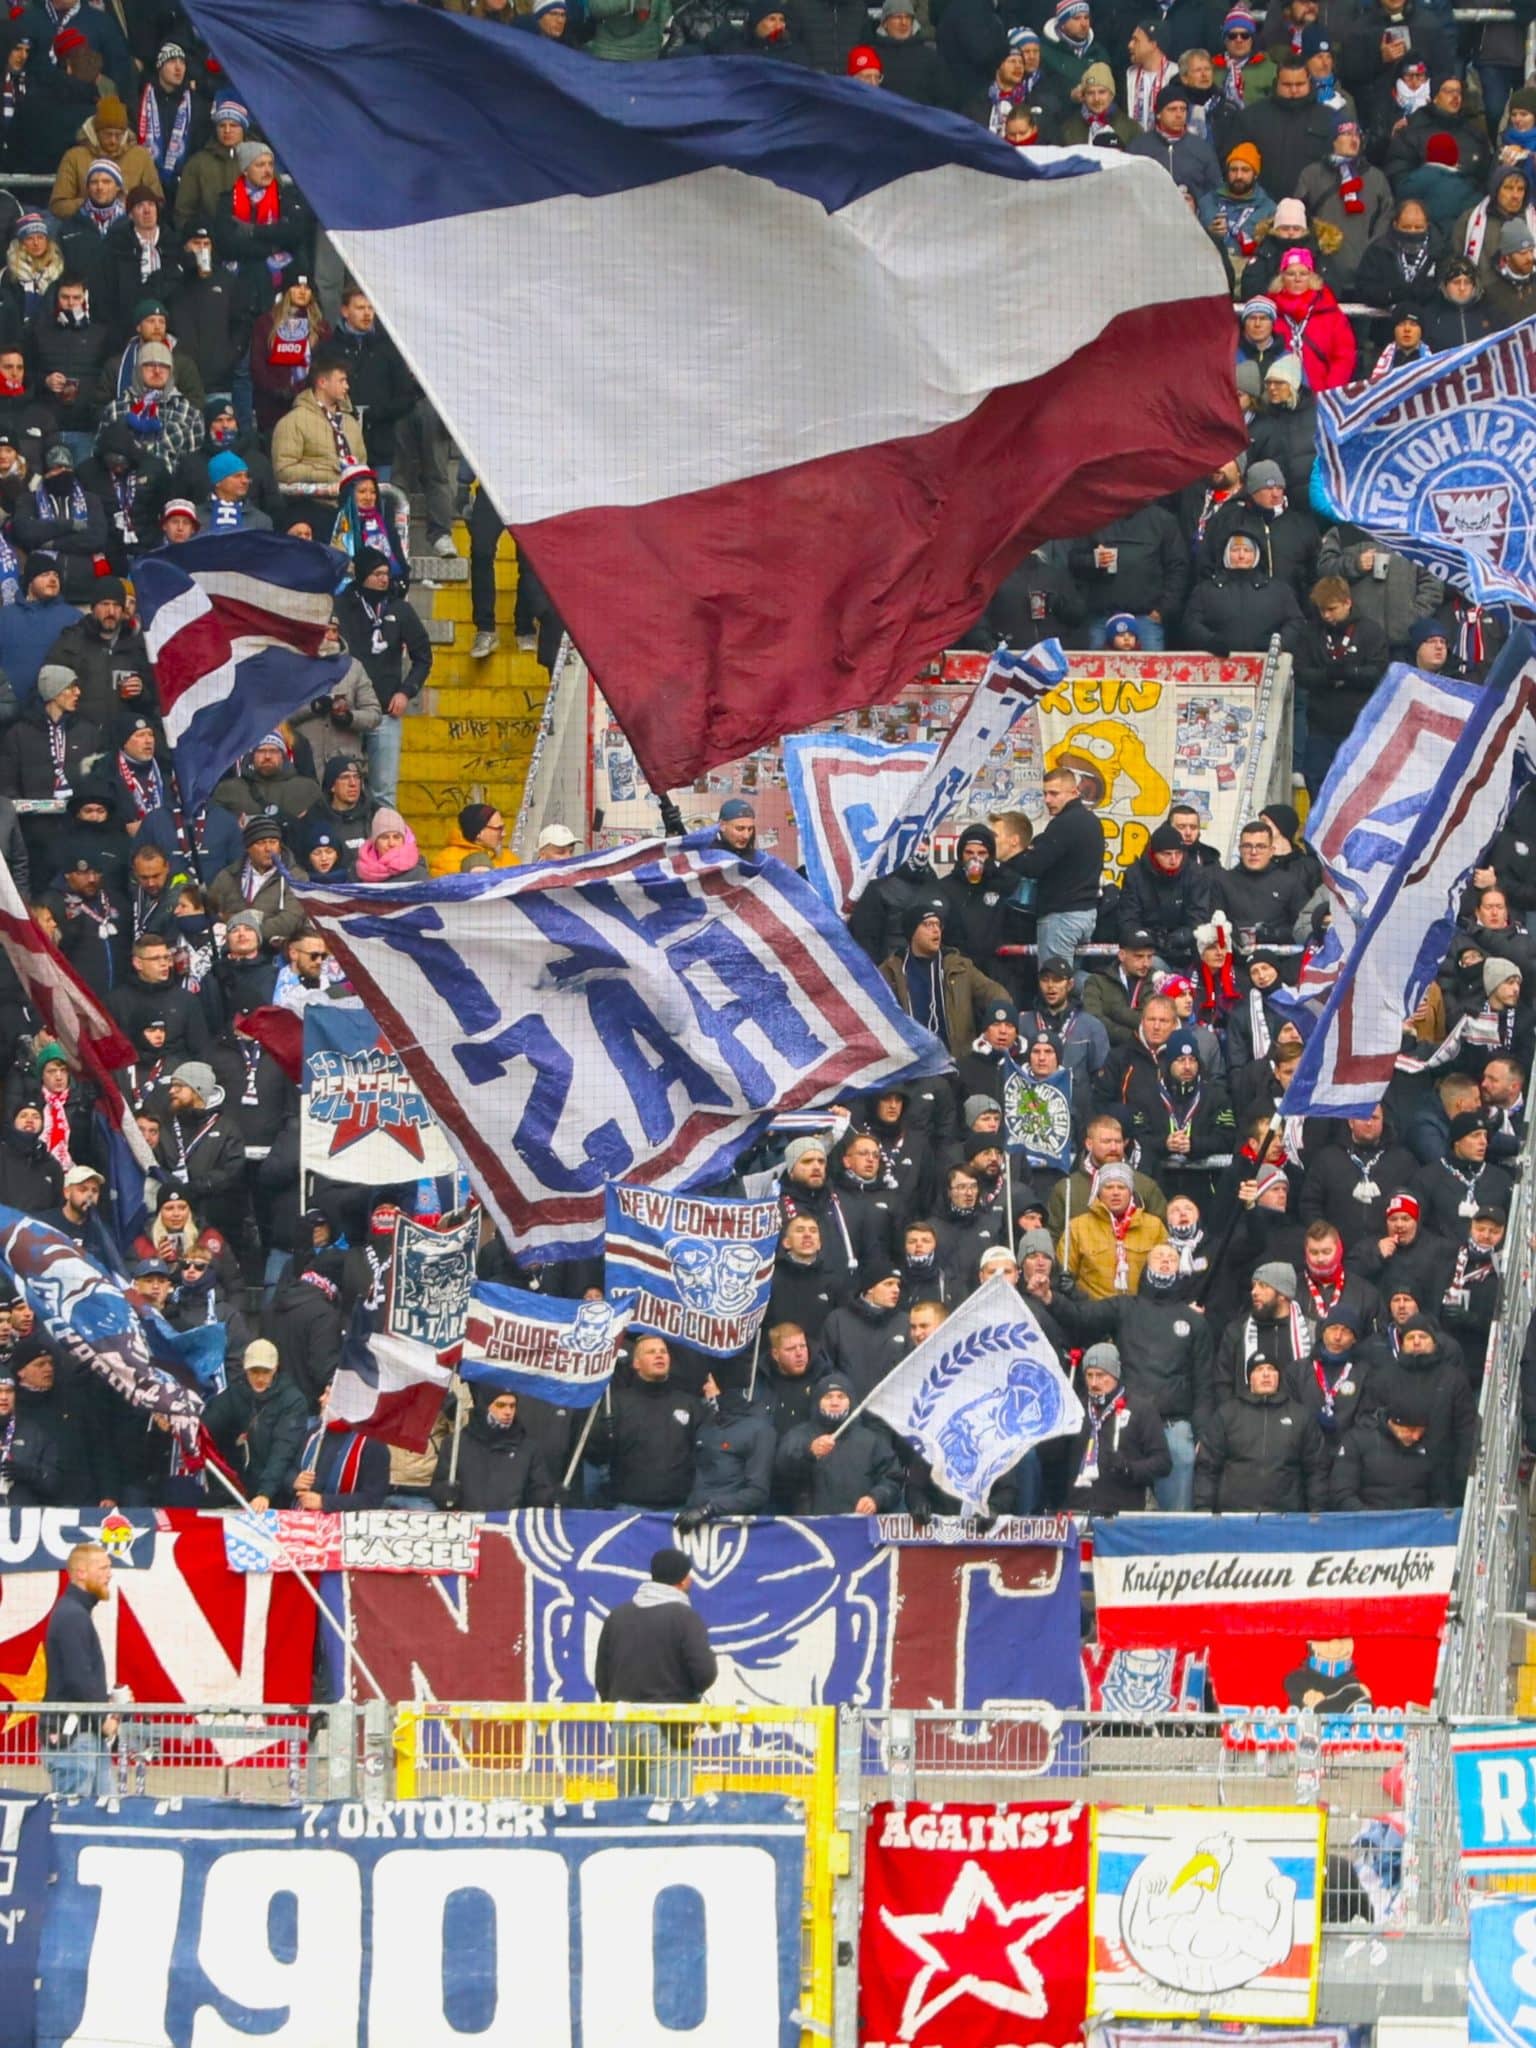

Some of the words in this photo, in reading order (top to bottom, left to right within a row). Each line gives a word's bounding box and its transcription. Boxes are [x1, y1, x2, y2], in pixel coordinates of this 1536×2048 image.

[1039, 679, 1163, 715] KEIN
[616, 1187, 671, 1231] NEW
[491, 1314, 560, 1346] YOUNG
[485, 1338, 618, 1377] CONNECTION
[344, 1511, 474, 1540] HESSEN
[344, 1537, 472, 1569] KASSEL
[1121, 1557, 1295, 1601] Knüppelduun
[1306, 1547, 1436, 1591] Eckernföör
[301, 1803, 329, 1838] 7.
[337, 1801, 547, 1838] OKTOBER
[880, 1809, 1080, 1851] AGAINST
[62, 1845, 780, 2048] 1900
